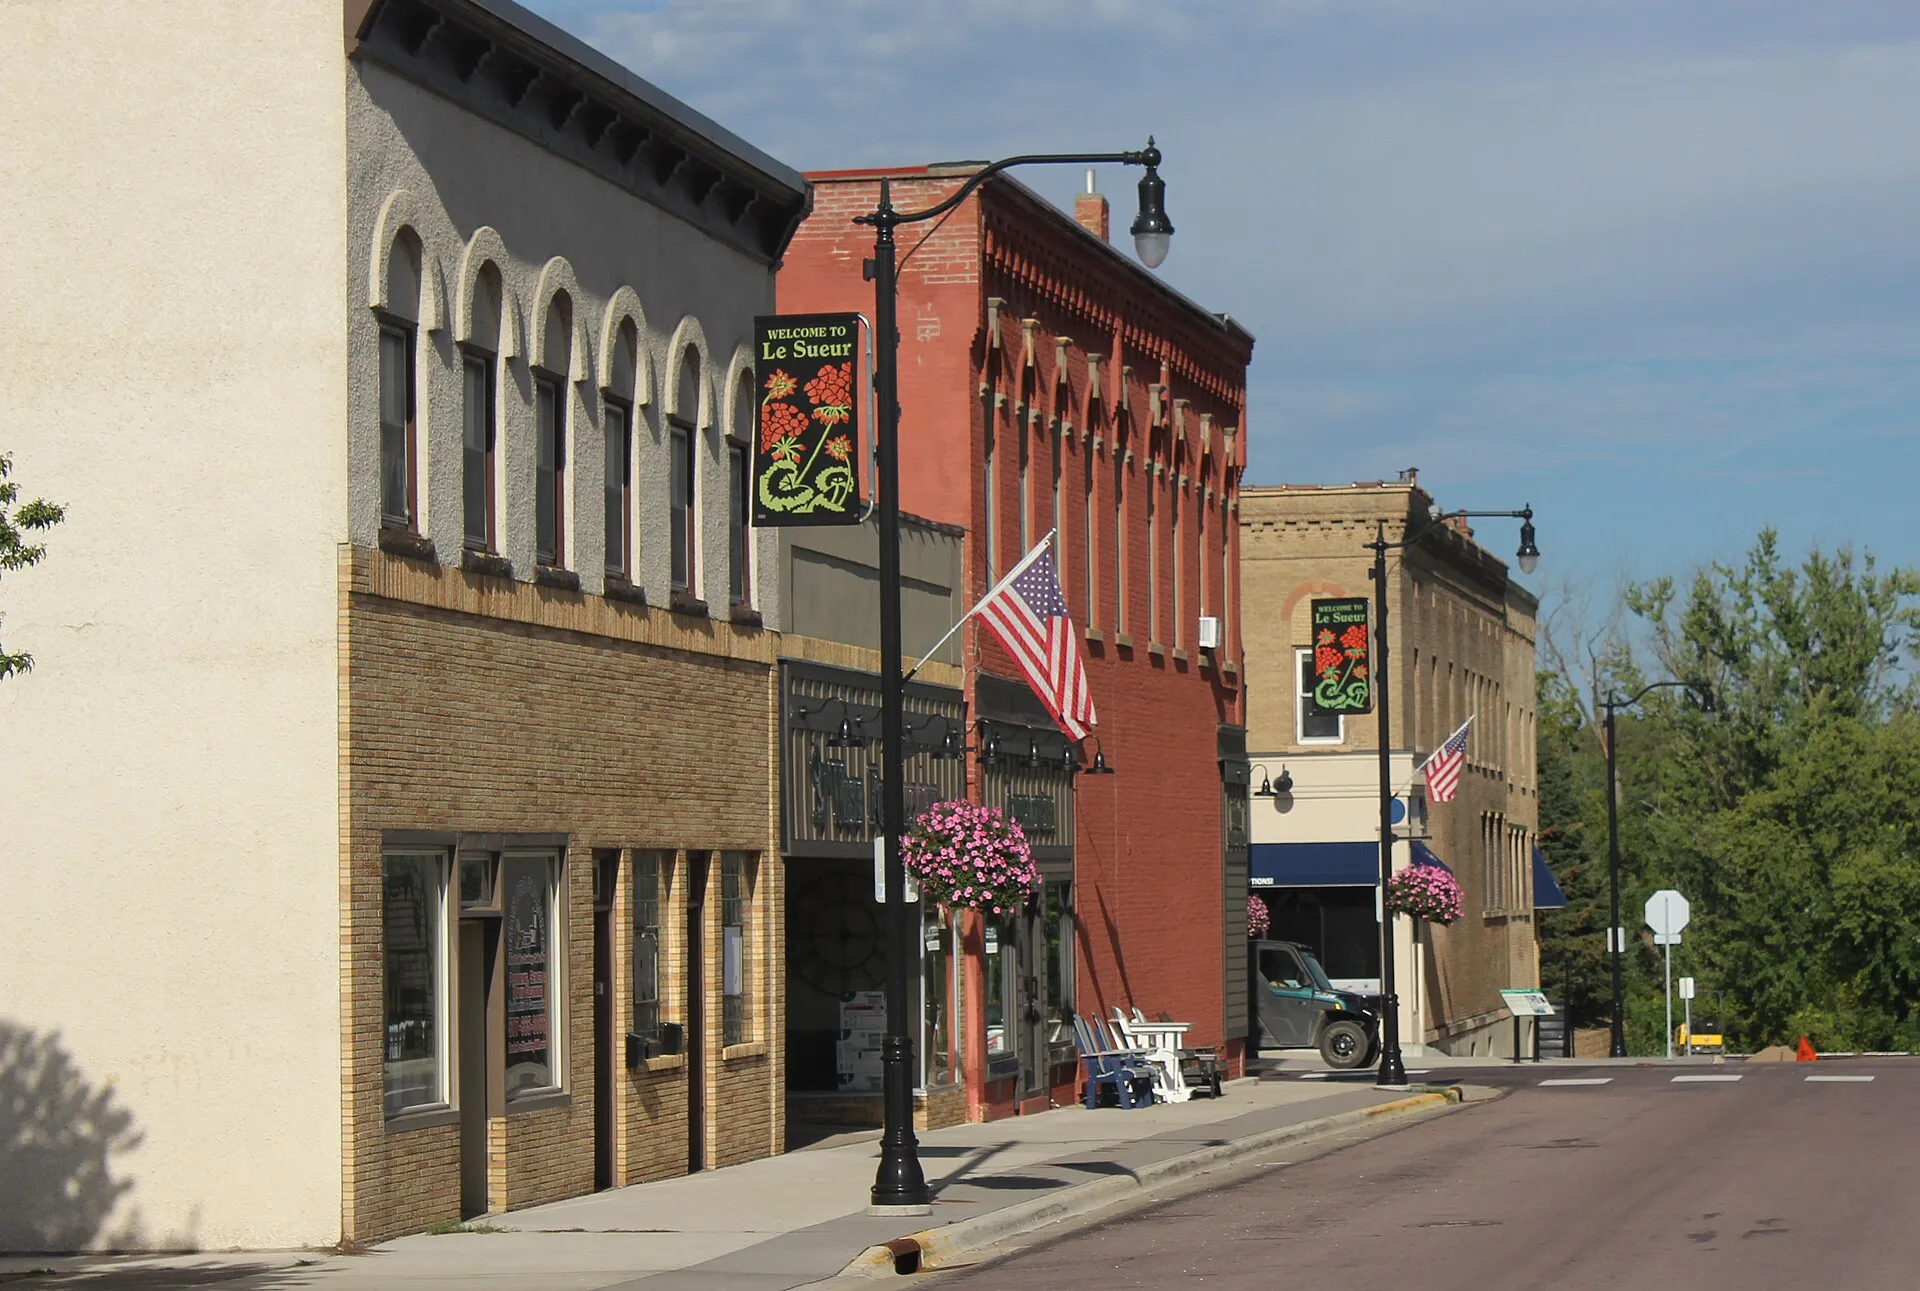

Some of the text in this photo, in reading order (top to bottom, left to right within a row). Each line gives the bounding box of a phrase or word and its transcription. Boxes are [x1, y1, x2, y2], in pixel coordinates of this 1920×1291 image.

[767, 326, 847, 339] WELCOME TO
[762, 340, 852, 360] Le Sueur
[1316, 613, 1365, 624] Le Sueur
